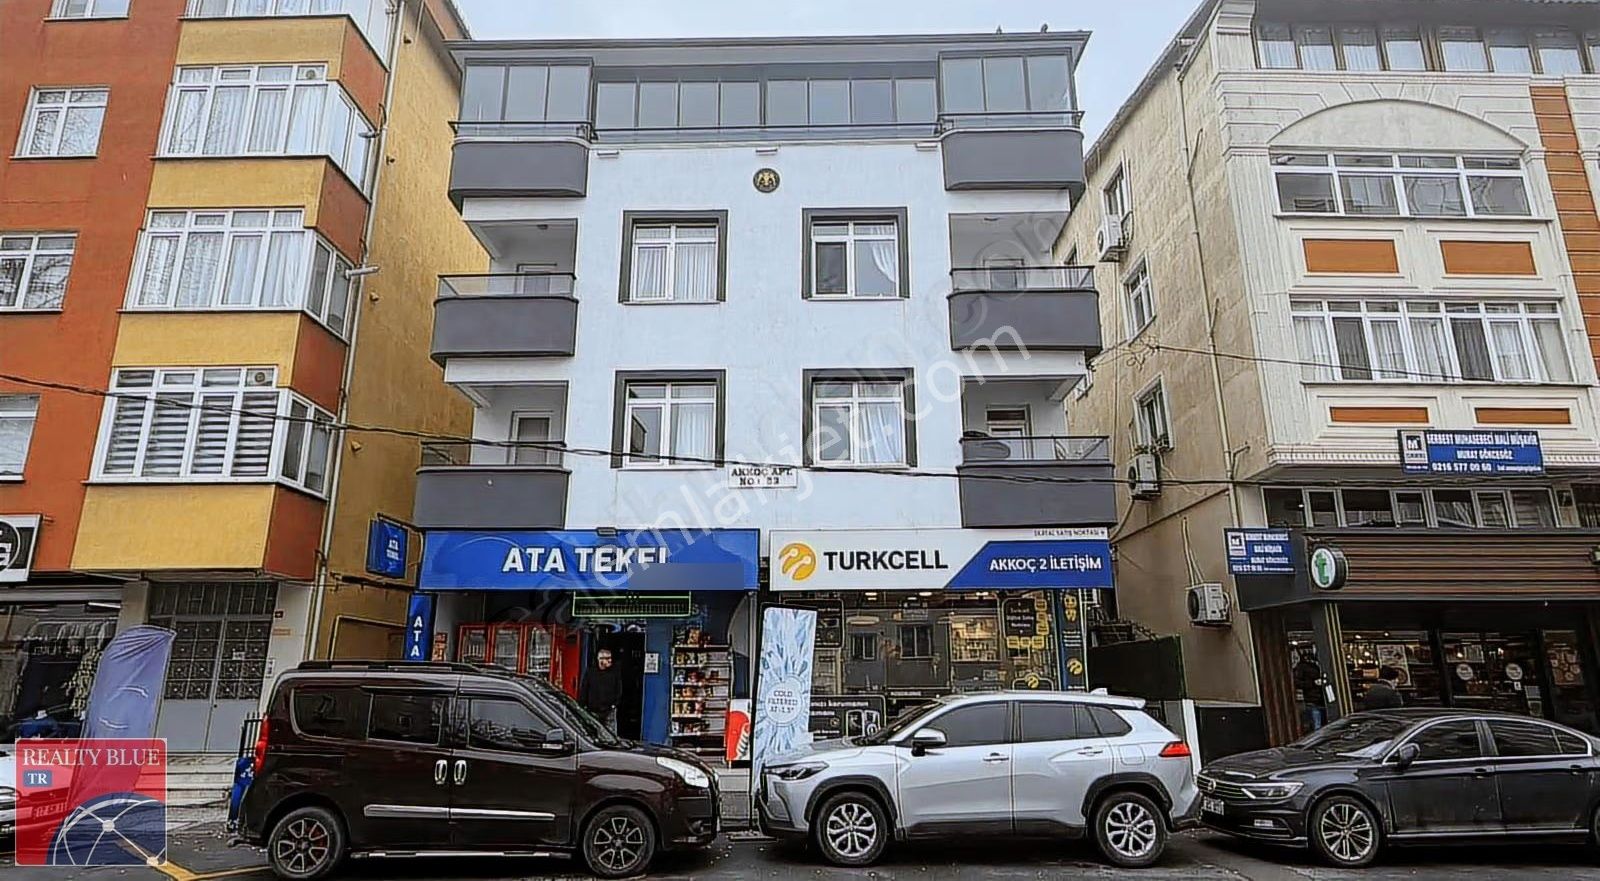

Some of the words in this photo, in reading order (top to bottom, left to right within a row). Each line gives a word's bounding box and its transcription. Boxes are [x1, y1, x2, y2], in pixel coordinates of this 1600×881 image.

[502, 547, 566, 573] ATA
[823, 550, 949, 571] TURKCELL
[989, 558, 1037, 573] AKKOÇ
[1039, 558, 1048, 570] 2
[1049, 554, 1102, 572] İLETİŞİM
[410, 615, 424, 657] ATA
